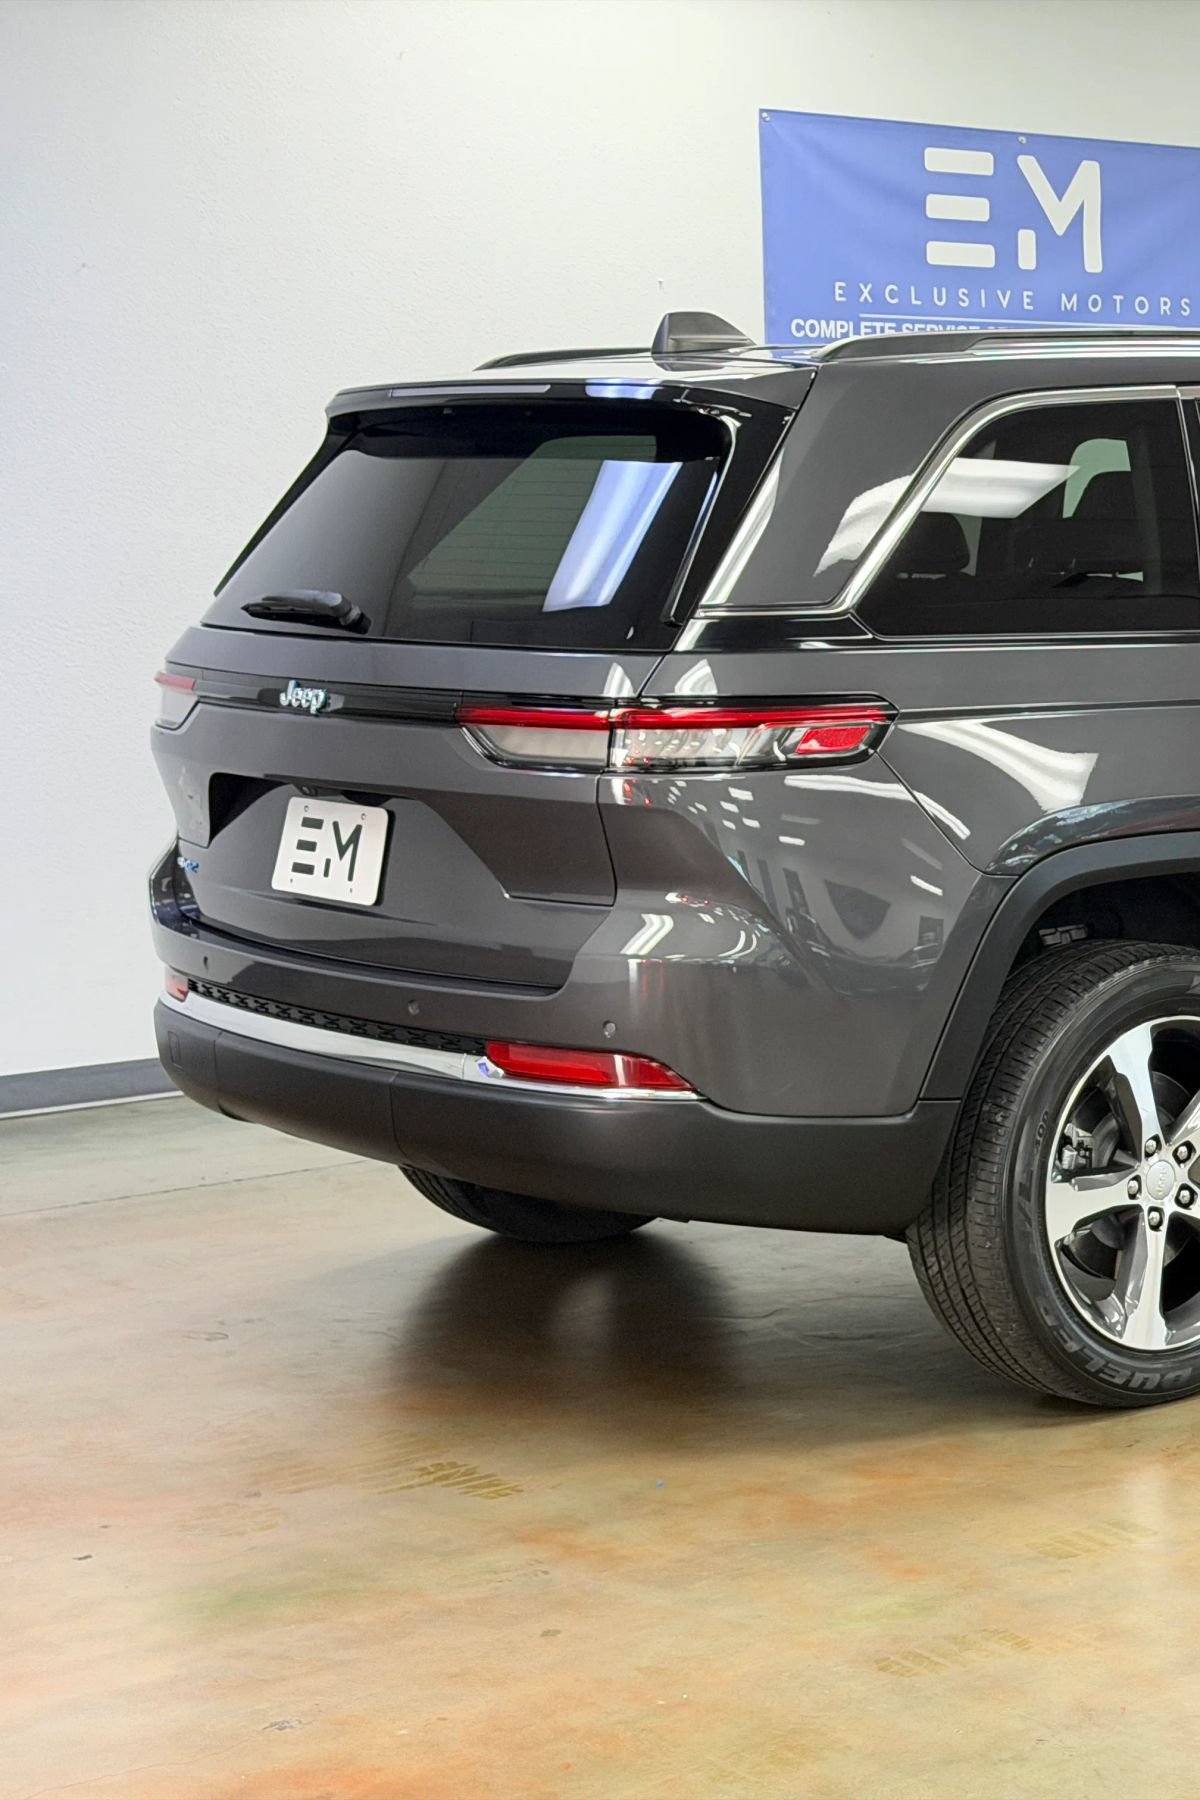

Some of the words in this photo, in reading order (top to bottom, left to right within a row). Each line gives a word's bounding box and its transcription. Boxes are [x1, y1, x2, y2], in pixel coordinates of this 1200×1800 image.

[923, 146, 1103, 273] EM
[834, 281, 1034, 310] EXCLUSIVE
[1060, 293, 1191, 316] MOTORS
[279, 679, 326, 715] Jeep
[291, 816, 362, 882] EM
